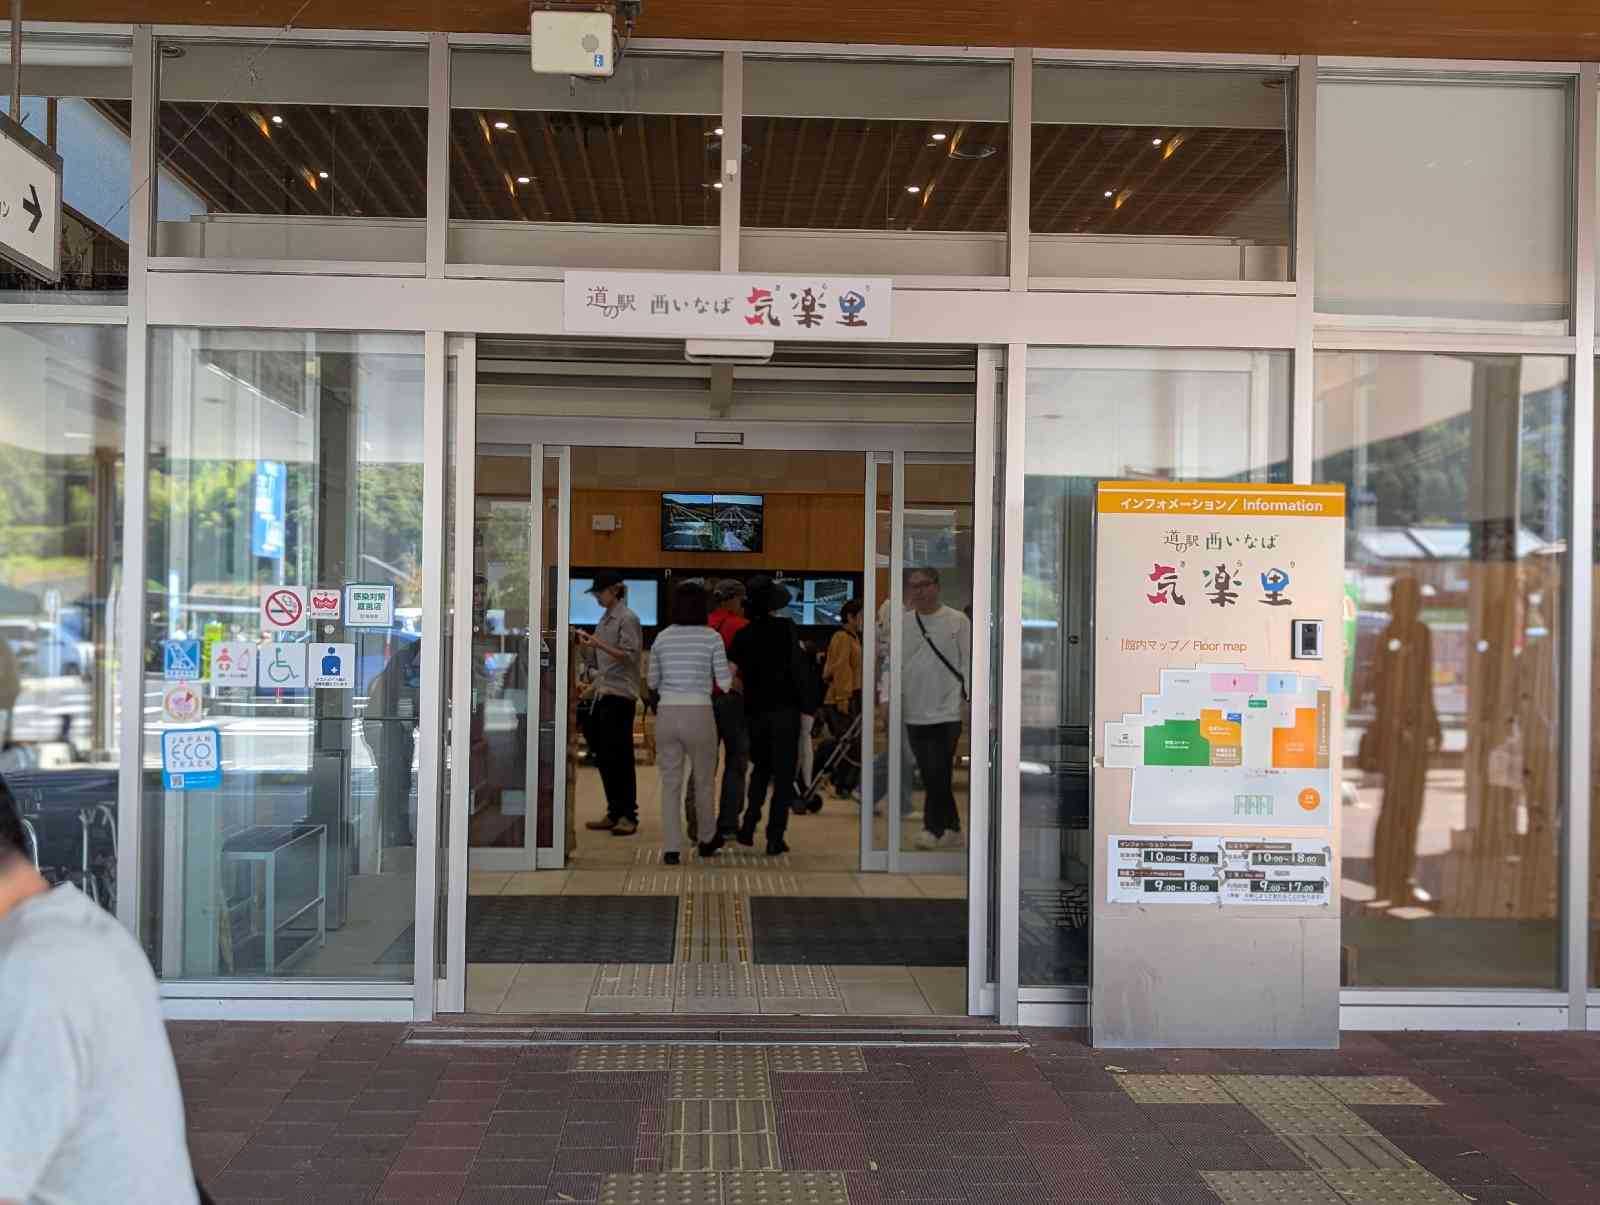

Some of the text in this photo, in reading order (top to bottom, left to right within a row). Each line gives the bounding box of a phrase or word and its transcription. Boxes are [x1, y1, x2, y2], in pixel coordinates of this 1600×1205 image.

[586, 286, 868, 329] 道の駅 西いなば 気楽里
[1243, 498, 1323, 513] Information
[1163, 528, 1280, 553] 道の駅 西いなば
[1146, 562, 1293, 608] 気楽里
[1193, 640, 1220, 651] Floor
[1223, 642, 1248, 653] map
[172, 743, 212, 760] ECO
